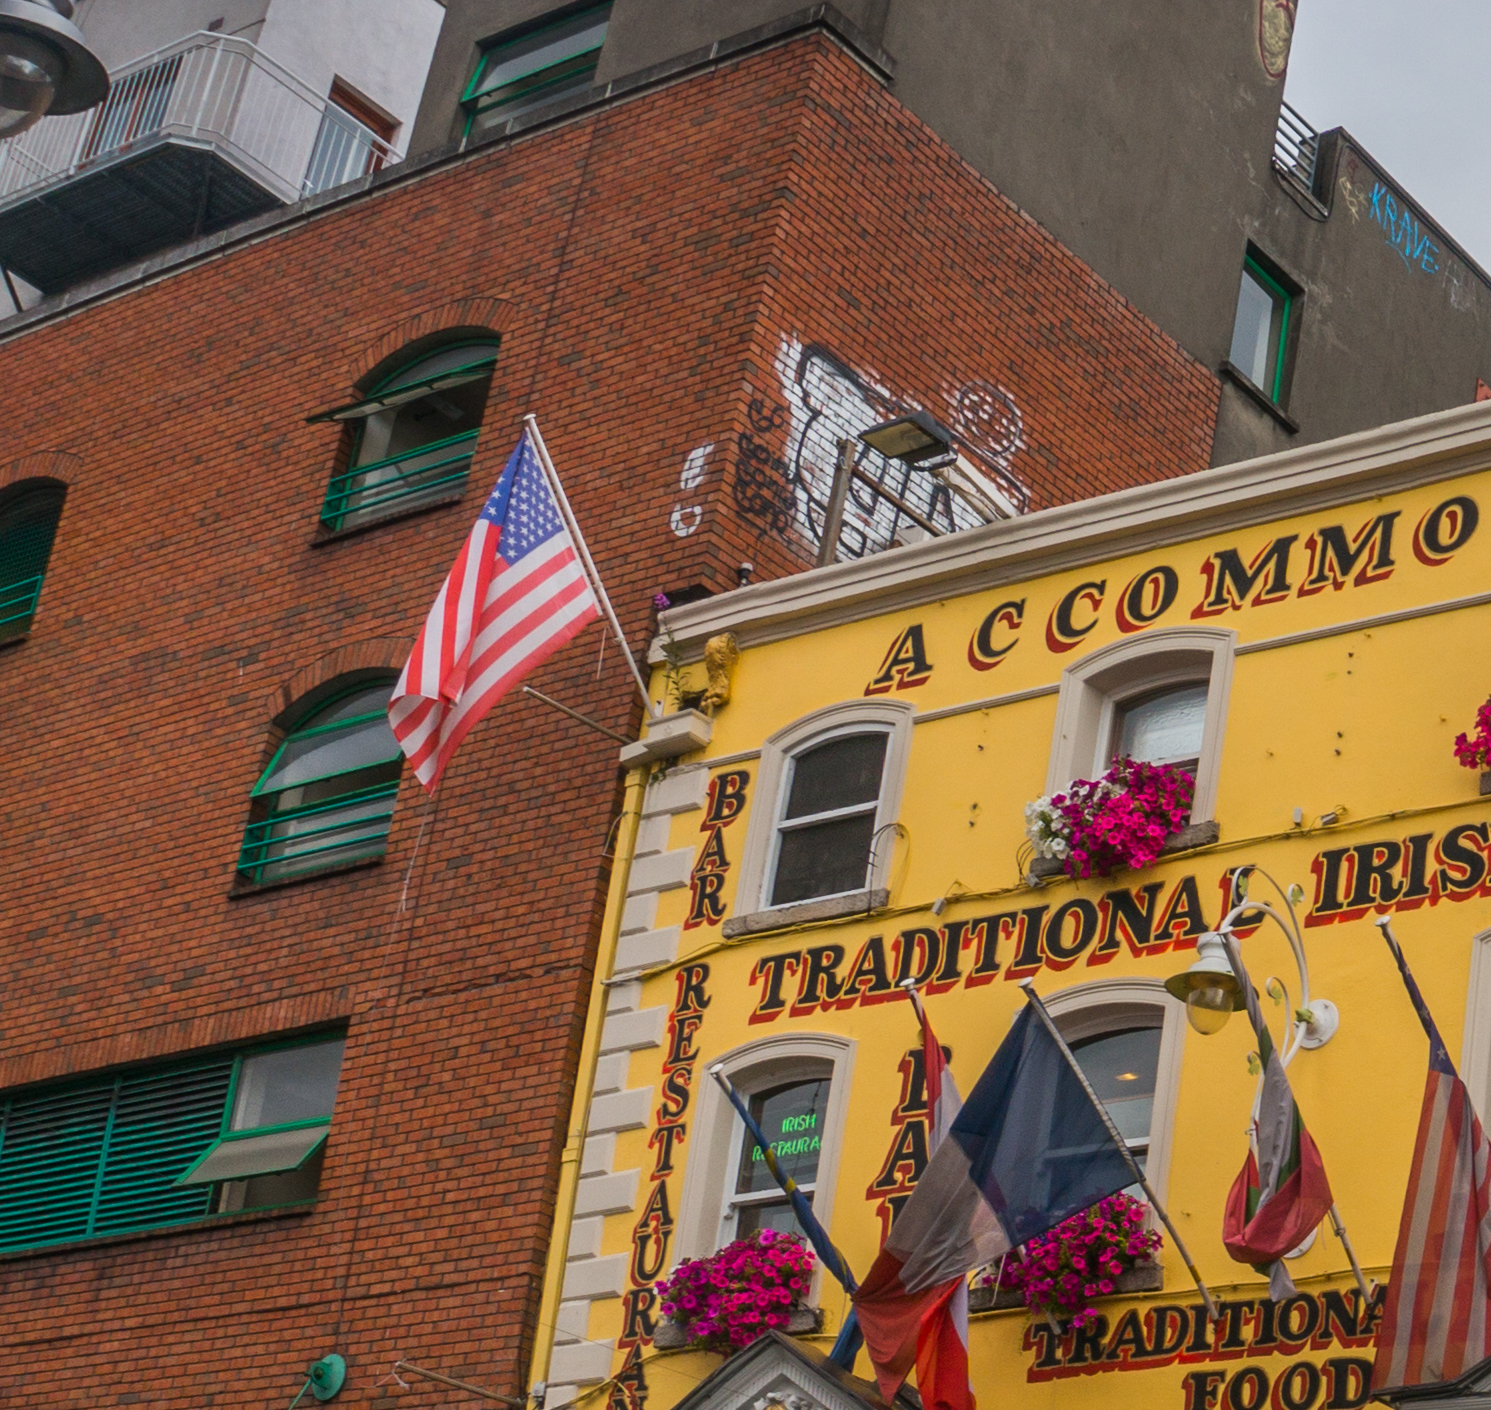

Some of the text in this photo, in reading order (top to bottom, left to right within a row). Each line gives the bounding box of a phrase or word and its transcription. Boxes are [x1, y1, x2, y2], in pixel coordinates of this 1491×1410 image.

[684, 769, 750, 929] BAR
[748, 865, 1264, 1025] TRADITIONAL
[782, 1114, 817, 1136] IRISH
[1022, 1282, 1387, 1384] TRADITIONA
